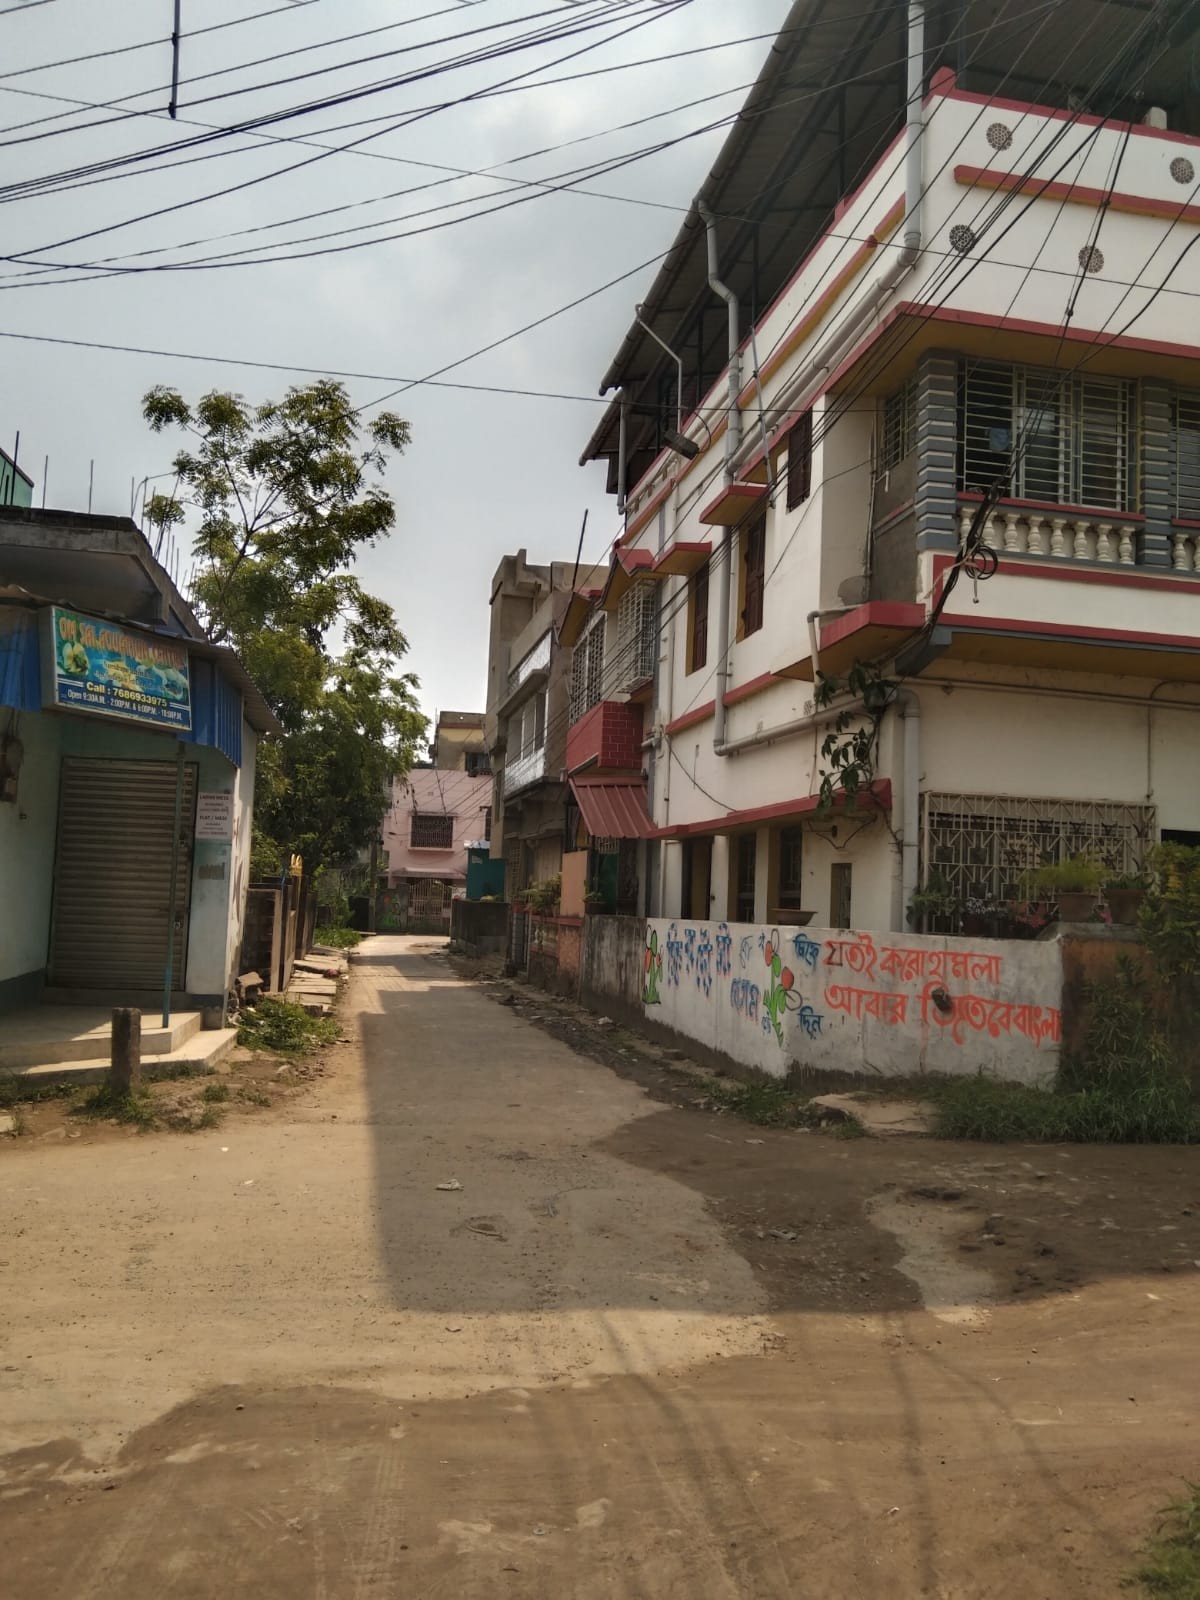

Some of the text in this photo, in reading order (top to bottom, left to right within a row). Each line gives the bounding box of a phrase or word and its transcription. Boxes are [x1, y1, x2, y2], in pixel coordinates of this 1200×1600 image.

[59, 616, 77, 641] OM
[67, 689, 82, 700] Open
[86, 681, 106, 694] Call
[113, 687, 168, 707] 7686933975
[823, 933, 878, 982] যতই
[824, 984, 909, 1025] আবার
[797, 1005, 824, 1040] দিন
